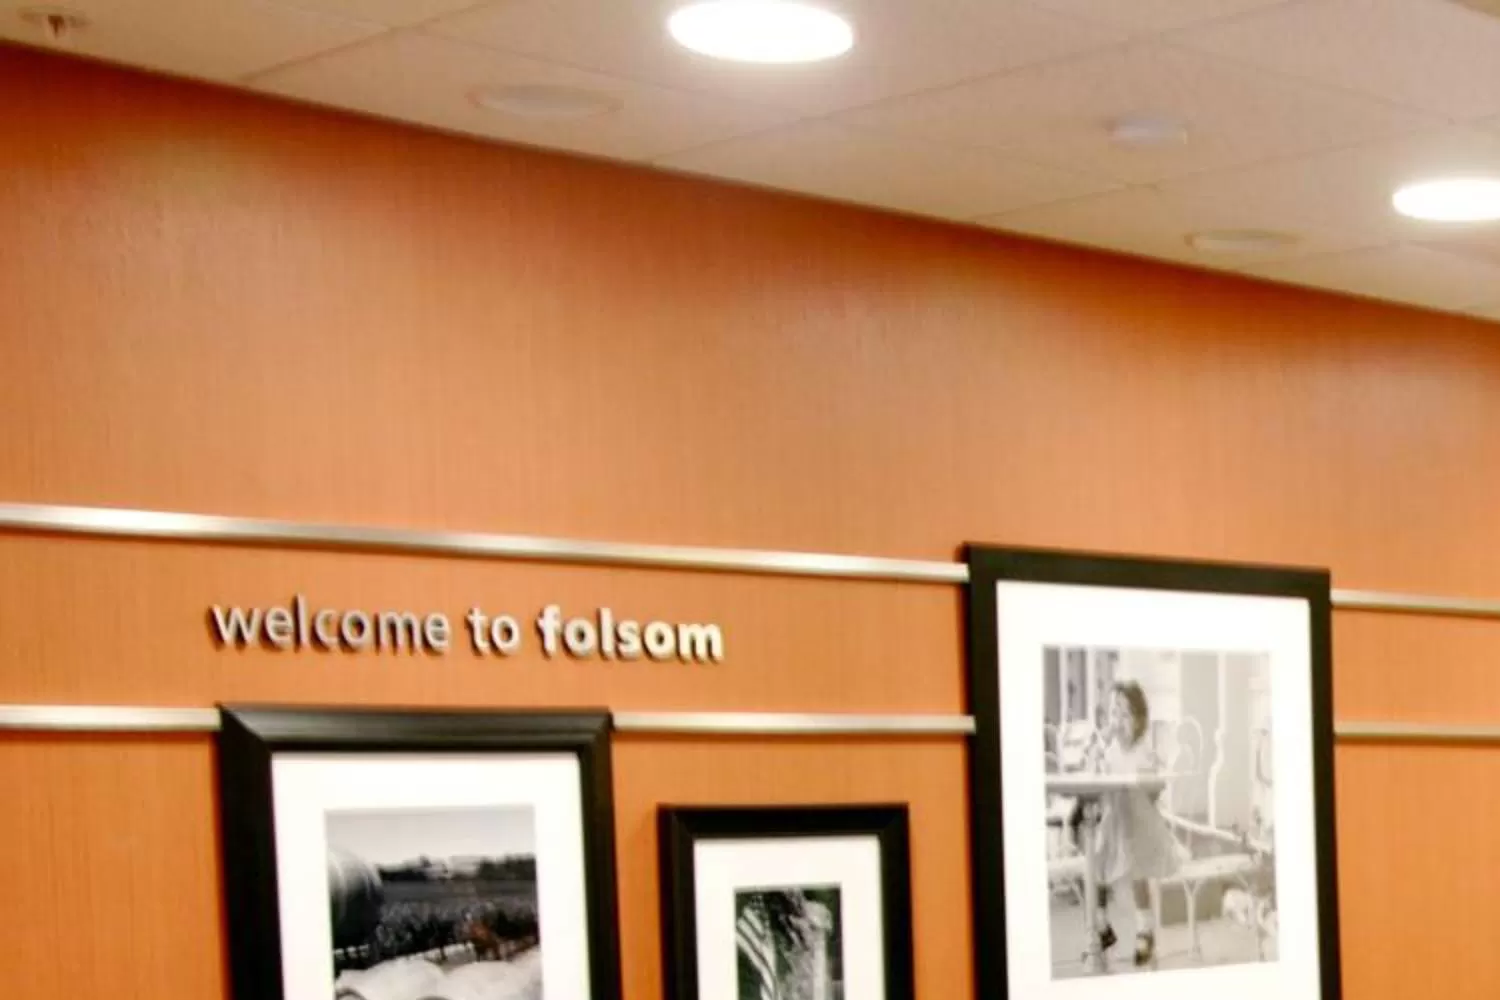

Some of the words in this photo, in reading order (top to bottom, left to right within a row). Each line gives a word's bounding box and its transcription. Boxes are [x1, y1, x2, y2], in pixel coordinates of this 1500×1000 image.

[209, 593, 452, 654] welcome
[468, 607, 521, 656] to
[537, 603, 725, 662] folsom
